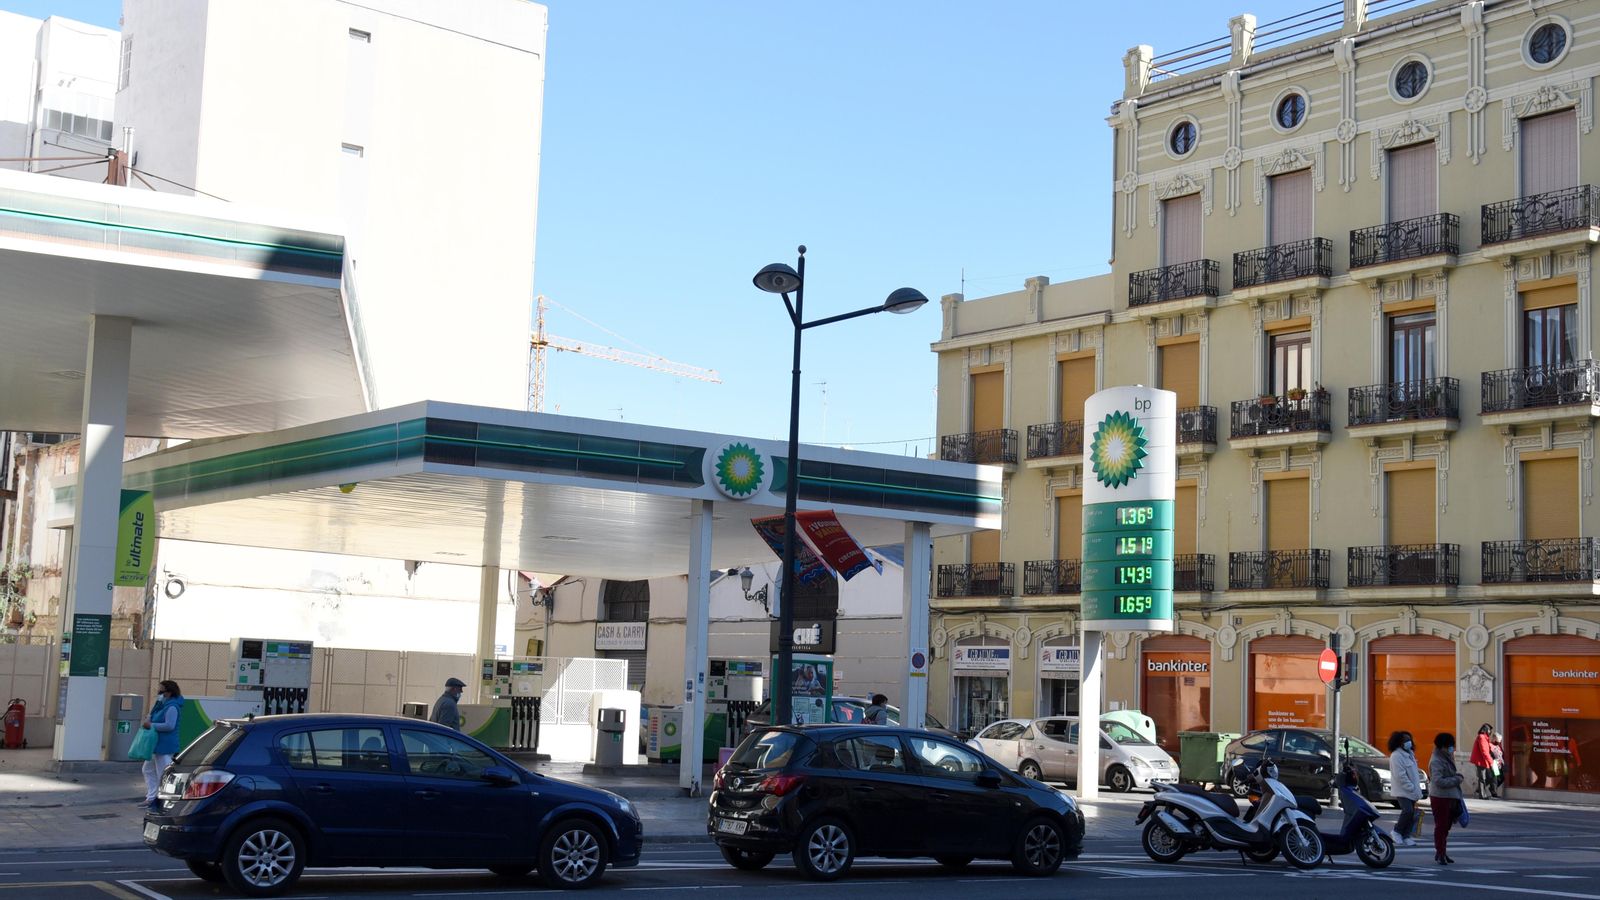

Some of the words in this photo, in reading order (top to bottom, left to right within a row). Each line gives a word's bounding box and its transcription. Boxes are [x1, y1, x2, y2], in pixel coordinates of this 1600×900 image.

[1135, 397, 1152, 413] bp
[130, 511, 144, 568] ultimate
[598, 626, 615, 638] CASH
[623, 626, 645, 638] CARRY
[240, 663, 246, 671] 6
[1552, 669, 1599, 678] bankinter
